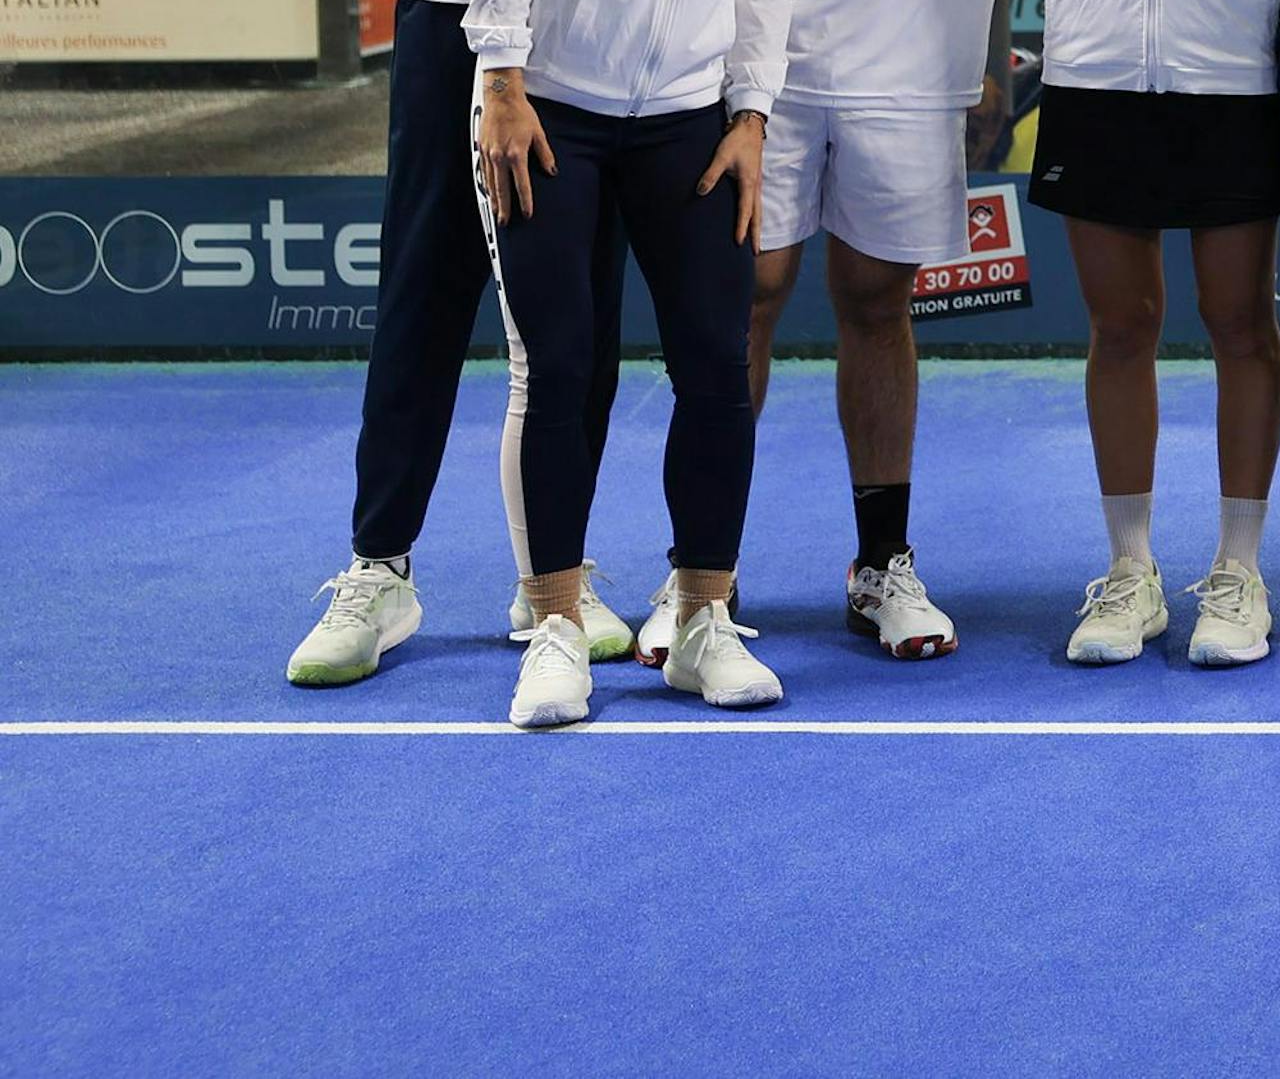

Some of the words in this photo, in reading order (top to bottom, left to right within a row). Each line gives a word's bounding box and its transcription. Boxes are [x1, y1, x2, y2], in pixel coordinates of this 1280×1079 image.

[924, 269, 950, 291] 30
[956, 265, 982, 286] 70
[987, 261, 1014, 282] 00
[952, 288, 1022, 310] GRATUITE
